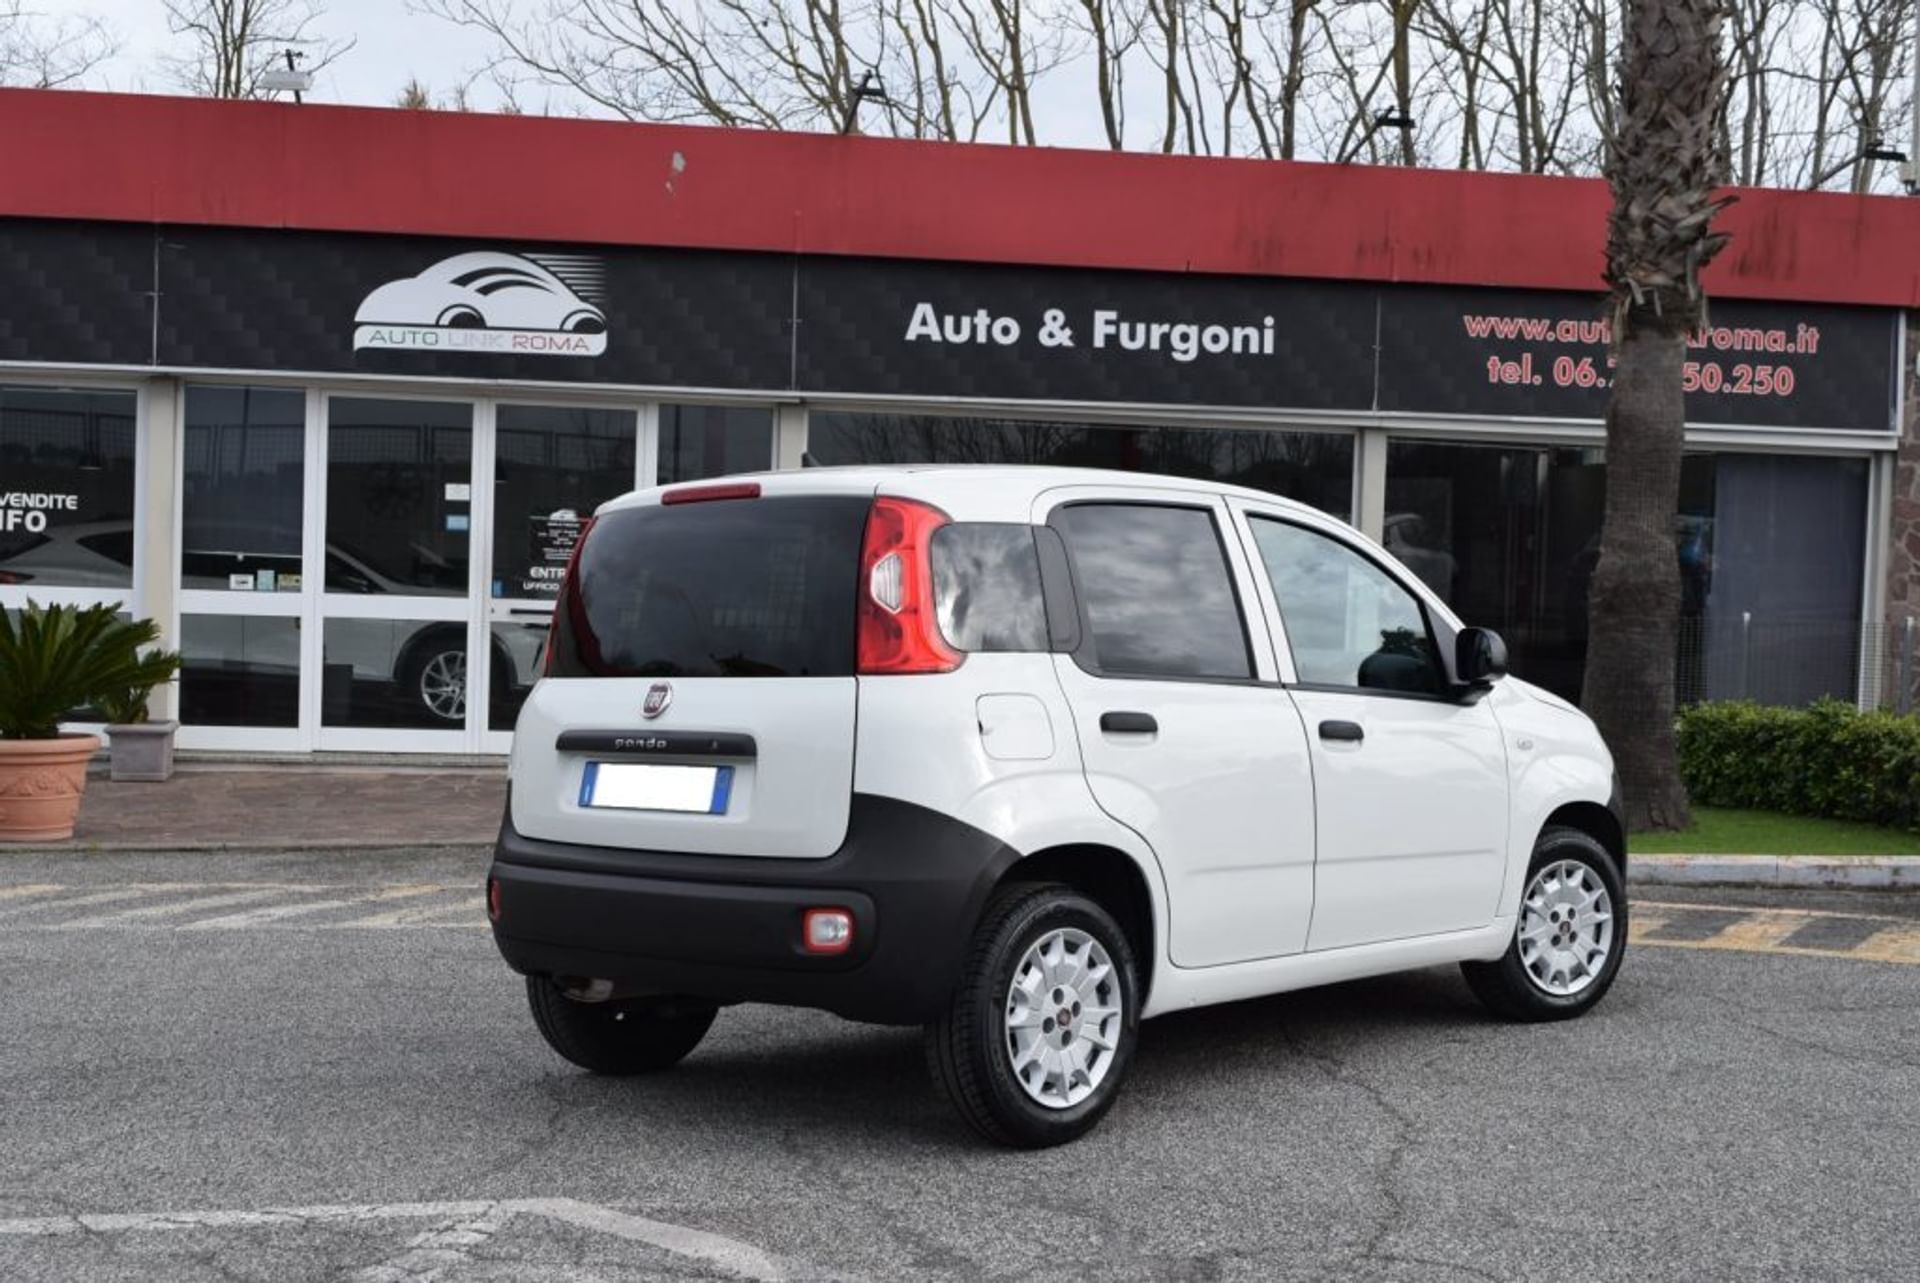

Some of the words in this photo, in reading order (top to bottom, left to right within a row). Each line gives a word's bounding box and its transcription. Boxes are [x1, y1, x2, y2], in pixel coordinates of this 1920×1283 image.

[369, 330, 438, 346] AUTO
[512, 334, 590, 351] ROMA
[905, 302, 1021, 345] Auto
[1038, 308, 1075, 347] &
[1093, 310, 1275, 362] Furgoni
[1464, 314, 1820, 354] www.autroma.it
[1487, 353, 1542, 386] tel.
[0, 508, 47, 534] FO
